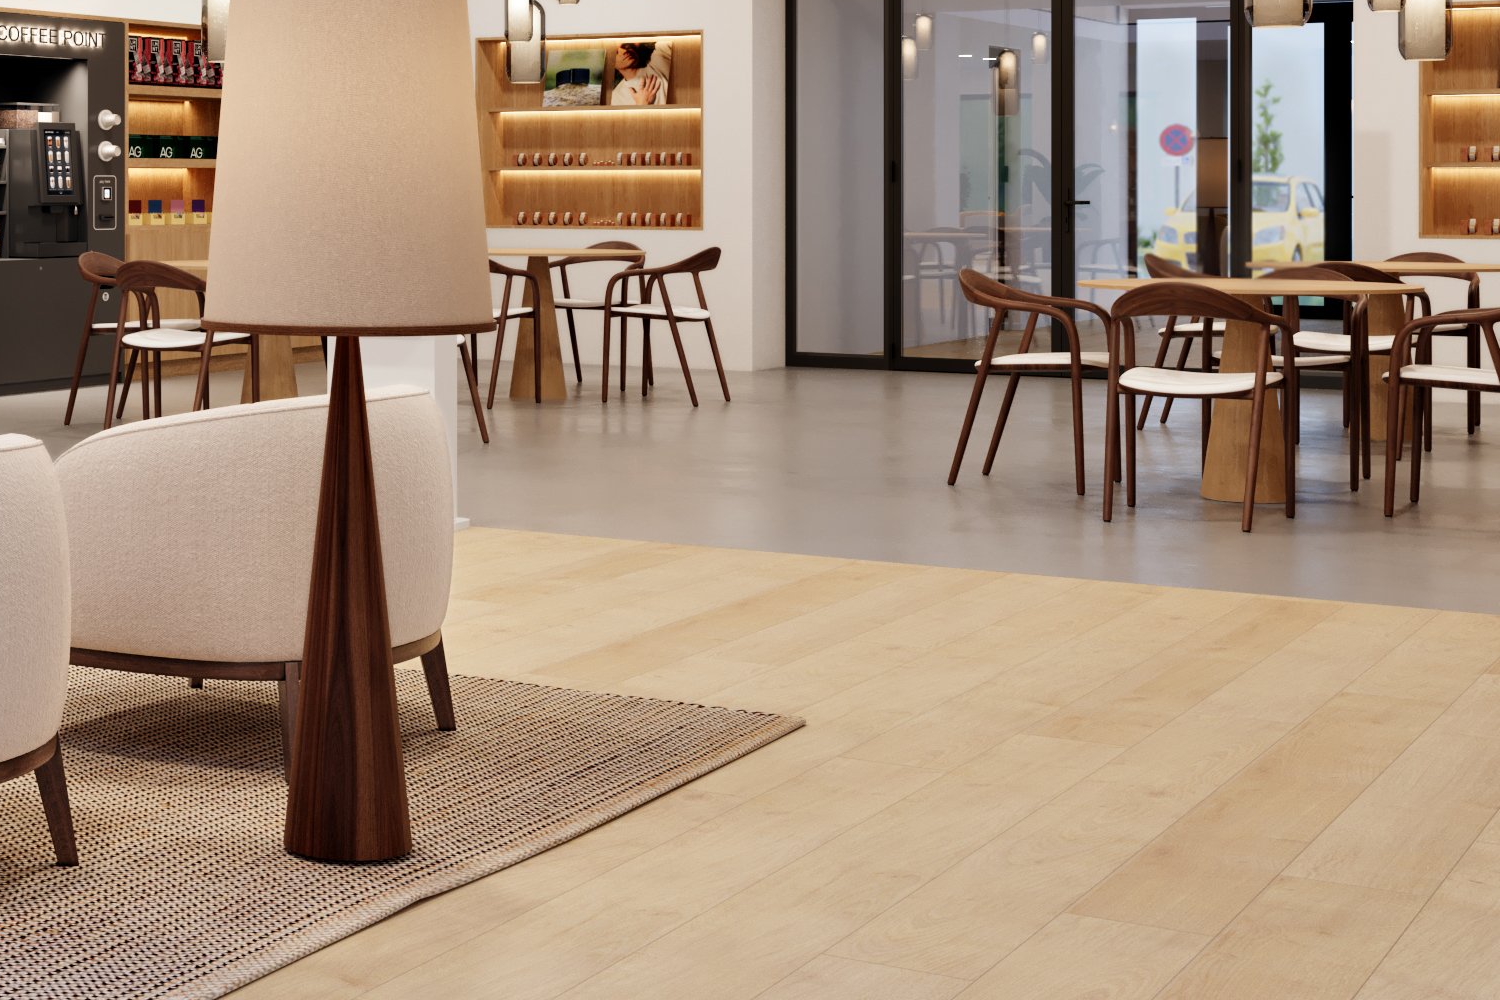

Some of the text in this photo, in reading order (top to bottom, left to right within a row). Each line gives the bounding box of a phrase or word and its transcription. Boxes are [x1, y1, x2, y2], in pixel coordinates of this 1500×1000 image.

[63, 30, 106, 48] POINT
[129, 146, 142, 158] AG
[160, 146, 173, 158] AG
[190, 147, 203, 159] AG
